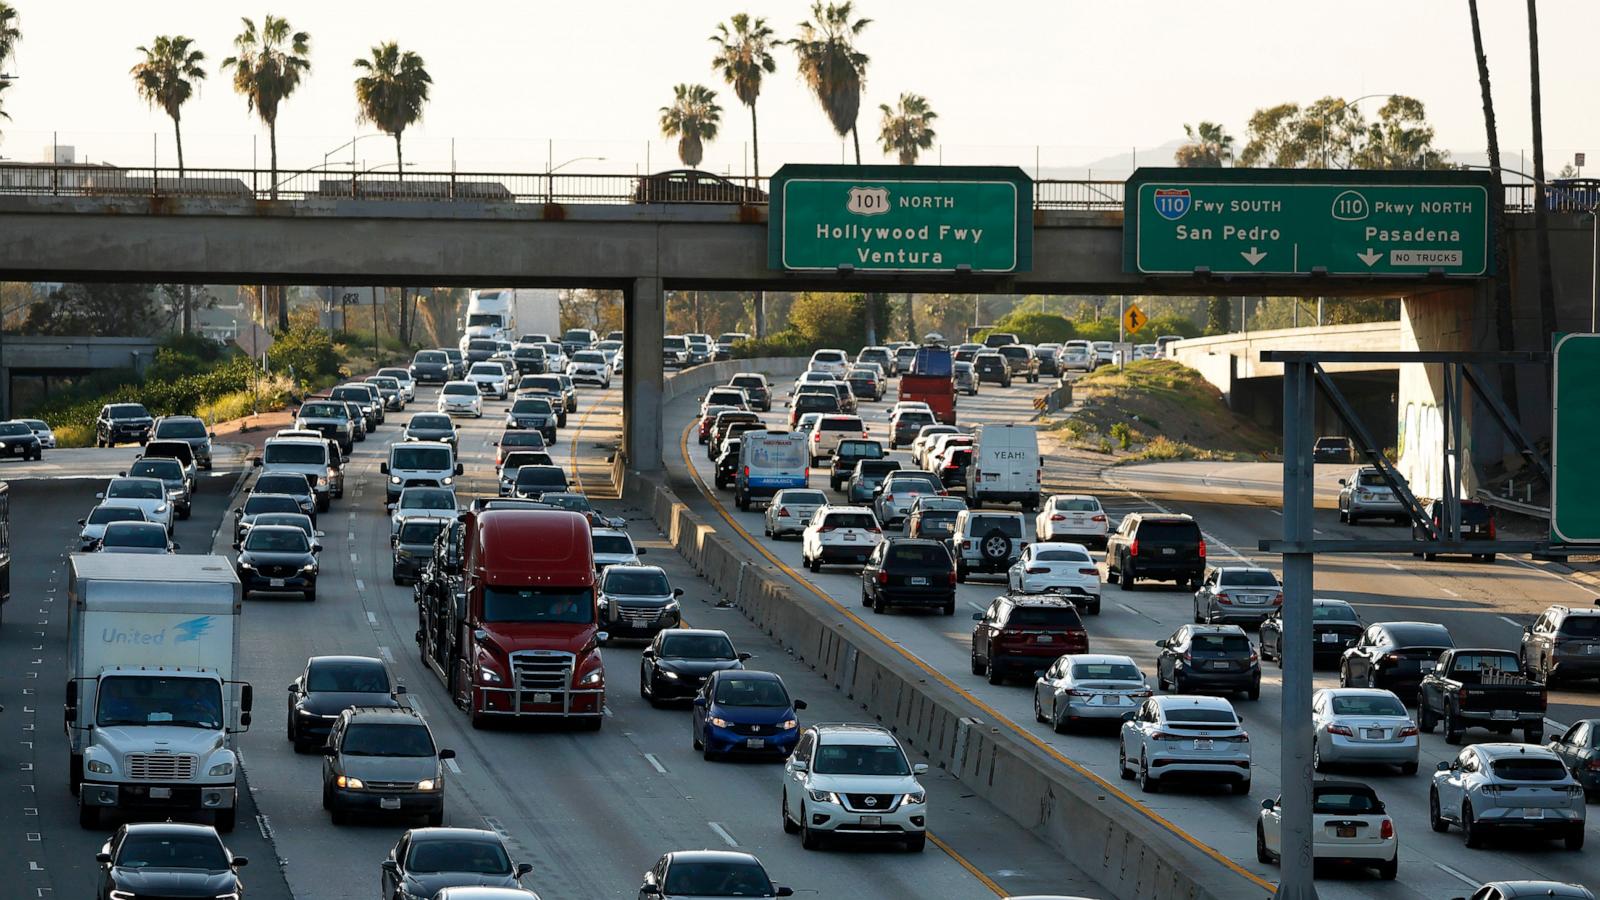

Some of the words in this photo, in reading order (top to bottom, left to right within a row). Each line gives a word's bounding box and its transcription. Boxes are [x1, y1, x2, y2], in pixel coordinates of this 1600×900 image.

[857, 194, 882, 209] 101
[899, 196, 954, 208] NORTH
[1160, 198, 1185, 213] 110
[1194, 199, 1225, 215] Fwy
[1230, 200, 1281, 212] SOUTH
[1339, 200, 1363, 214] 110
[1374, 201, 1415, 216] Pkwy
[1421, 201, 1472, 213] NORTH
[816, 223, 929, 243] Hollywood
[939, 225, 983, 244] Fwy
[1176, 225, 1212, 240] San
[1223, 225, 1280, 241] Pedro
[1365, 226, 1460, 242] Pasadena
[857, 247, 942, 264] Ventura
[1395, 253, 1410, 262] NO
[1416, 253, 1457, 262] TRUCKS
[994, 451, 1025, 460] YEAH!
[102, 627, 166, 645] United
